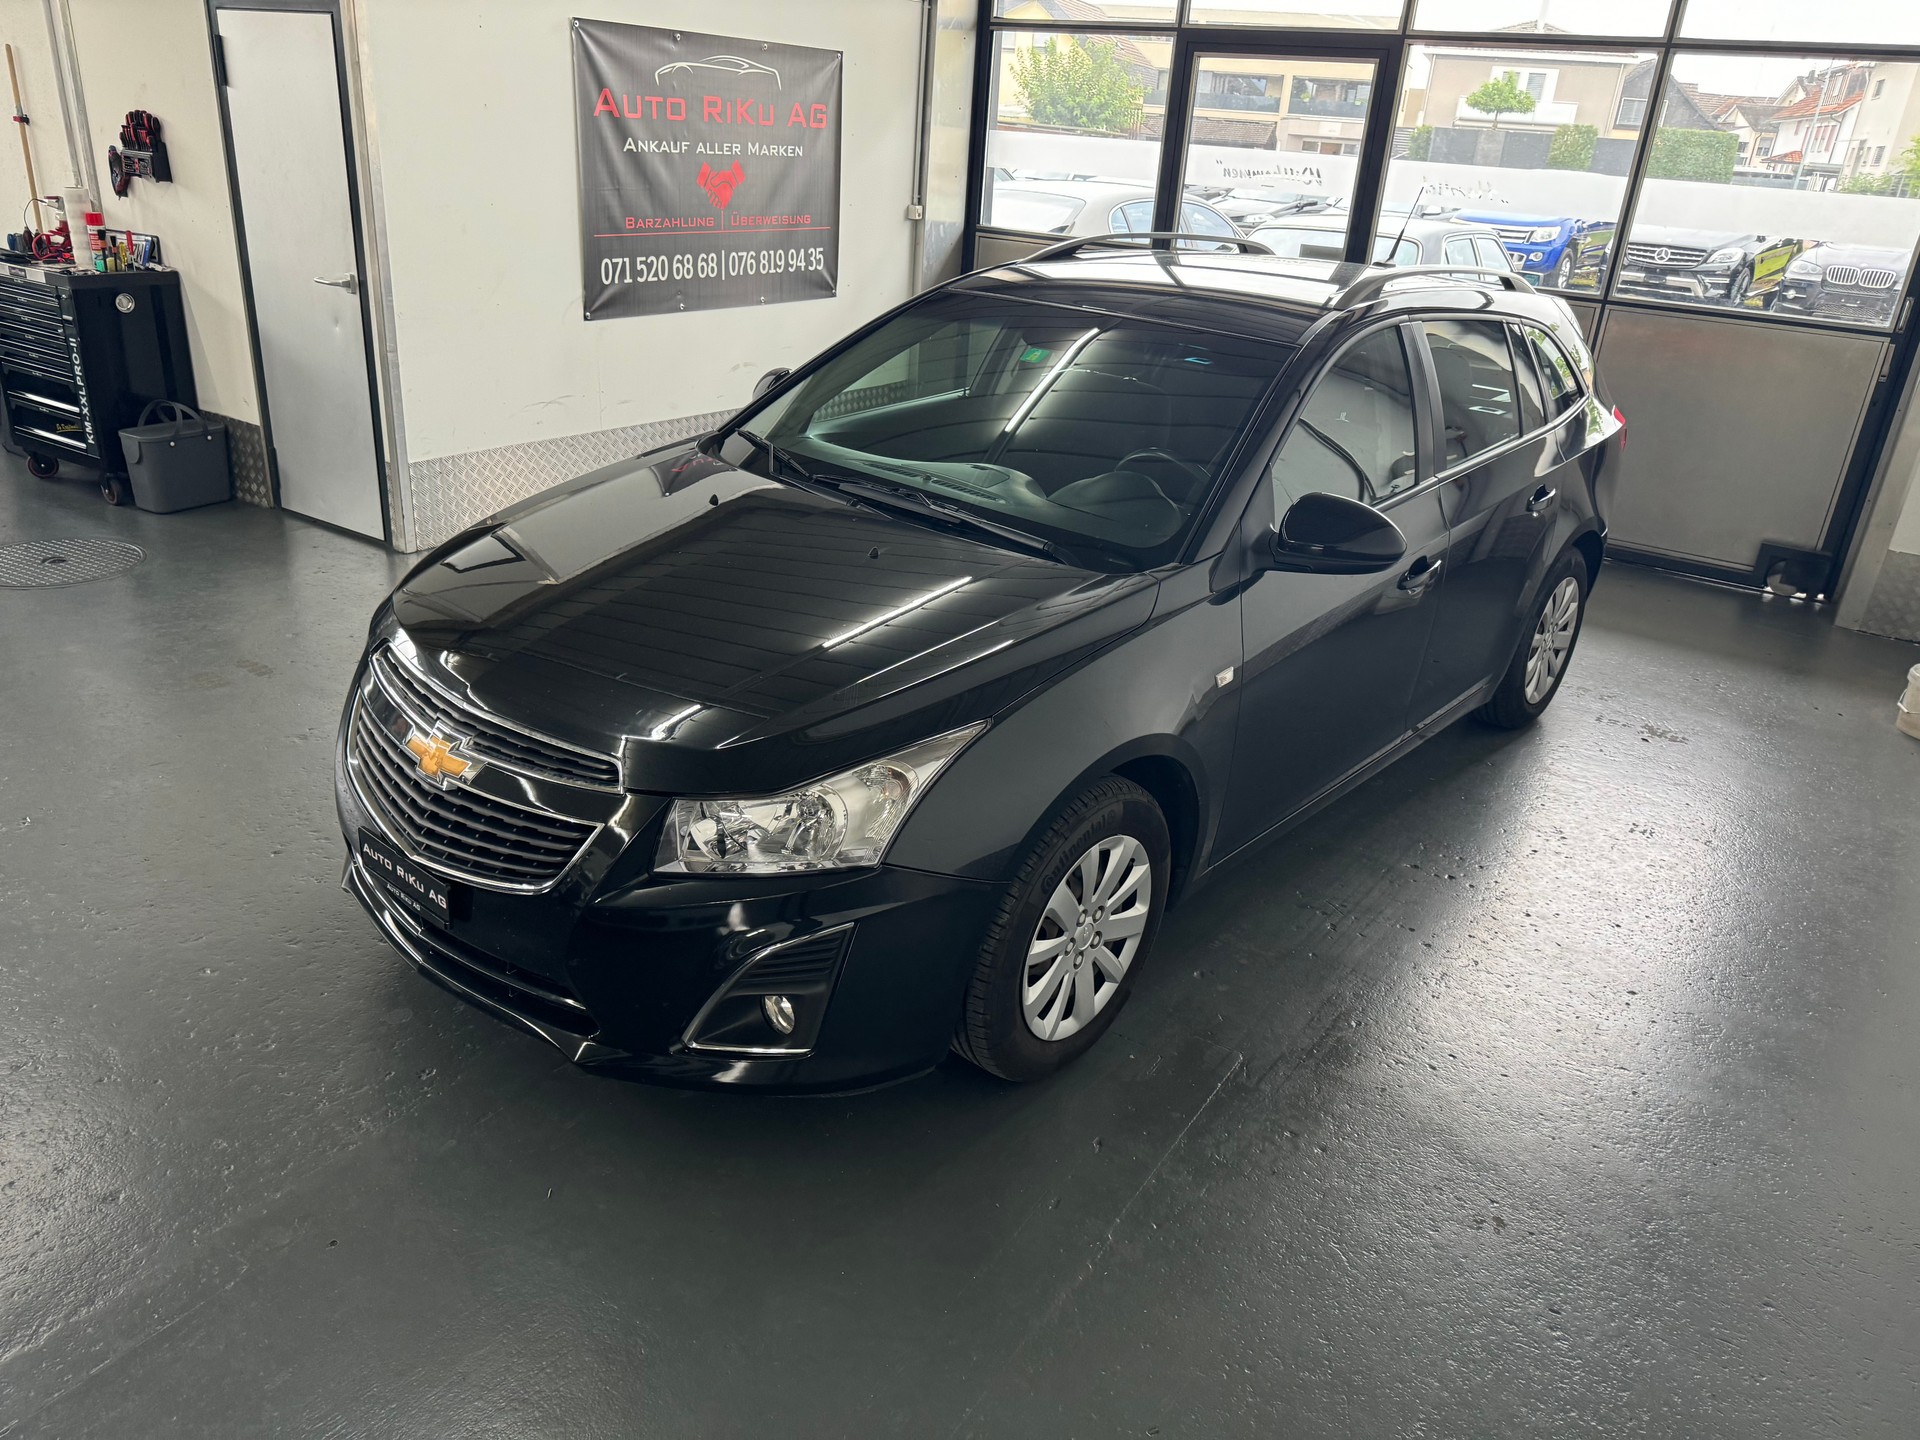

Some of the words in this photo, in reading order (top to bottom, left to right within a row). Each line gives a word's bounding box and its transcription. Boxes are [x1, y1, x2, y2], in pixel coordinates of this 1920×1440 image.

[593, 88, 686, 121] AUTO
[787, 102, 827, 129] AG
[623, 137, 690, 154] ANKAUF
[696, 142, 741, 155] ALLER
[747, 142, 803, 157] MARKEN
[625, 216, 715, 229] BARZAHLUNG
[601, 257, 633, 285] 071
[636, 255, 669, 282] 520
[672, 254, 694, 280] 68
[697, 252, 718, 278] 68
[728, 251, 756, 276] 076
[759, 249, 785, 274] 819
[788, 248, 806, 271] 94
[808, 247, 824, 270] 35
[69, 337, 95, 444] KM-XXLPRO-II
[363, 843, 392, 871] AUTO
[428, 889, 447, 909] AG
